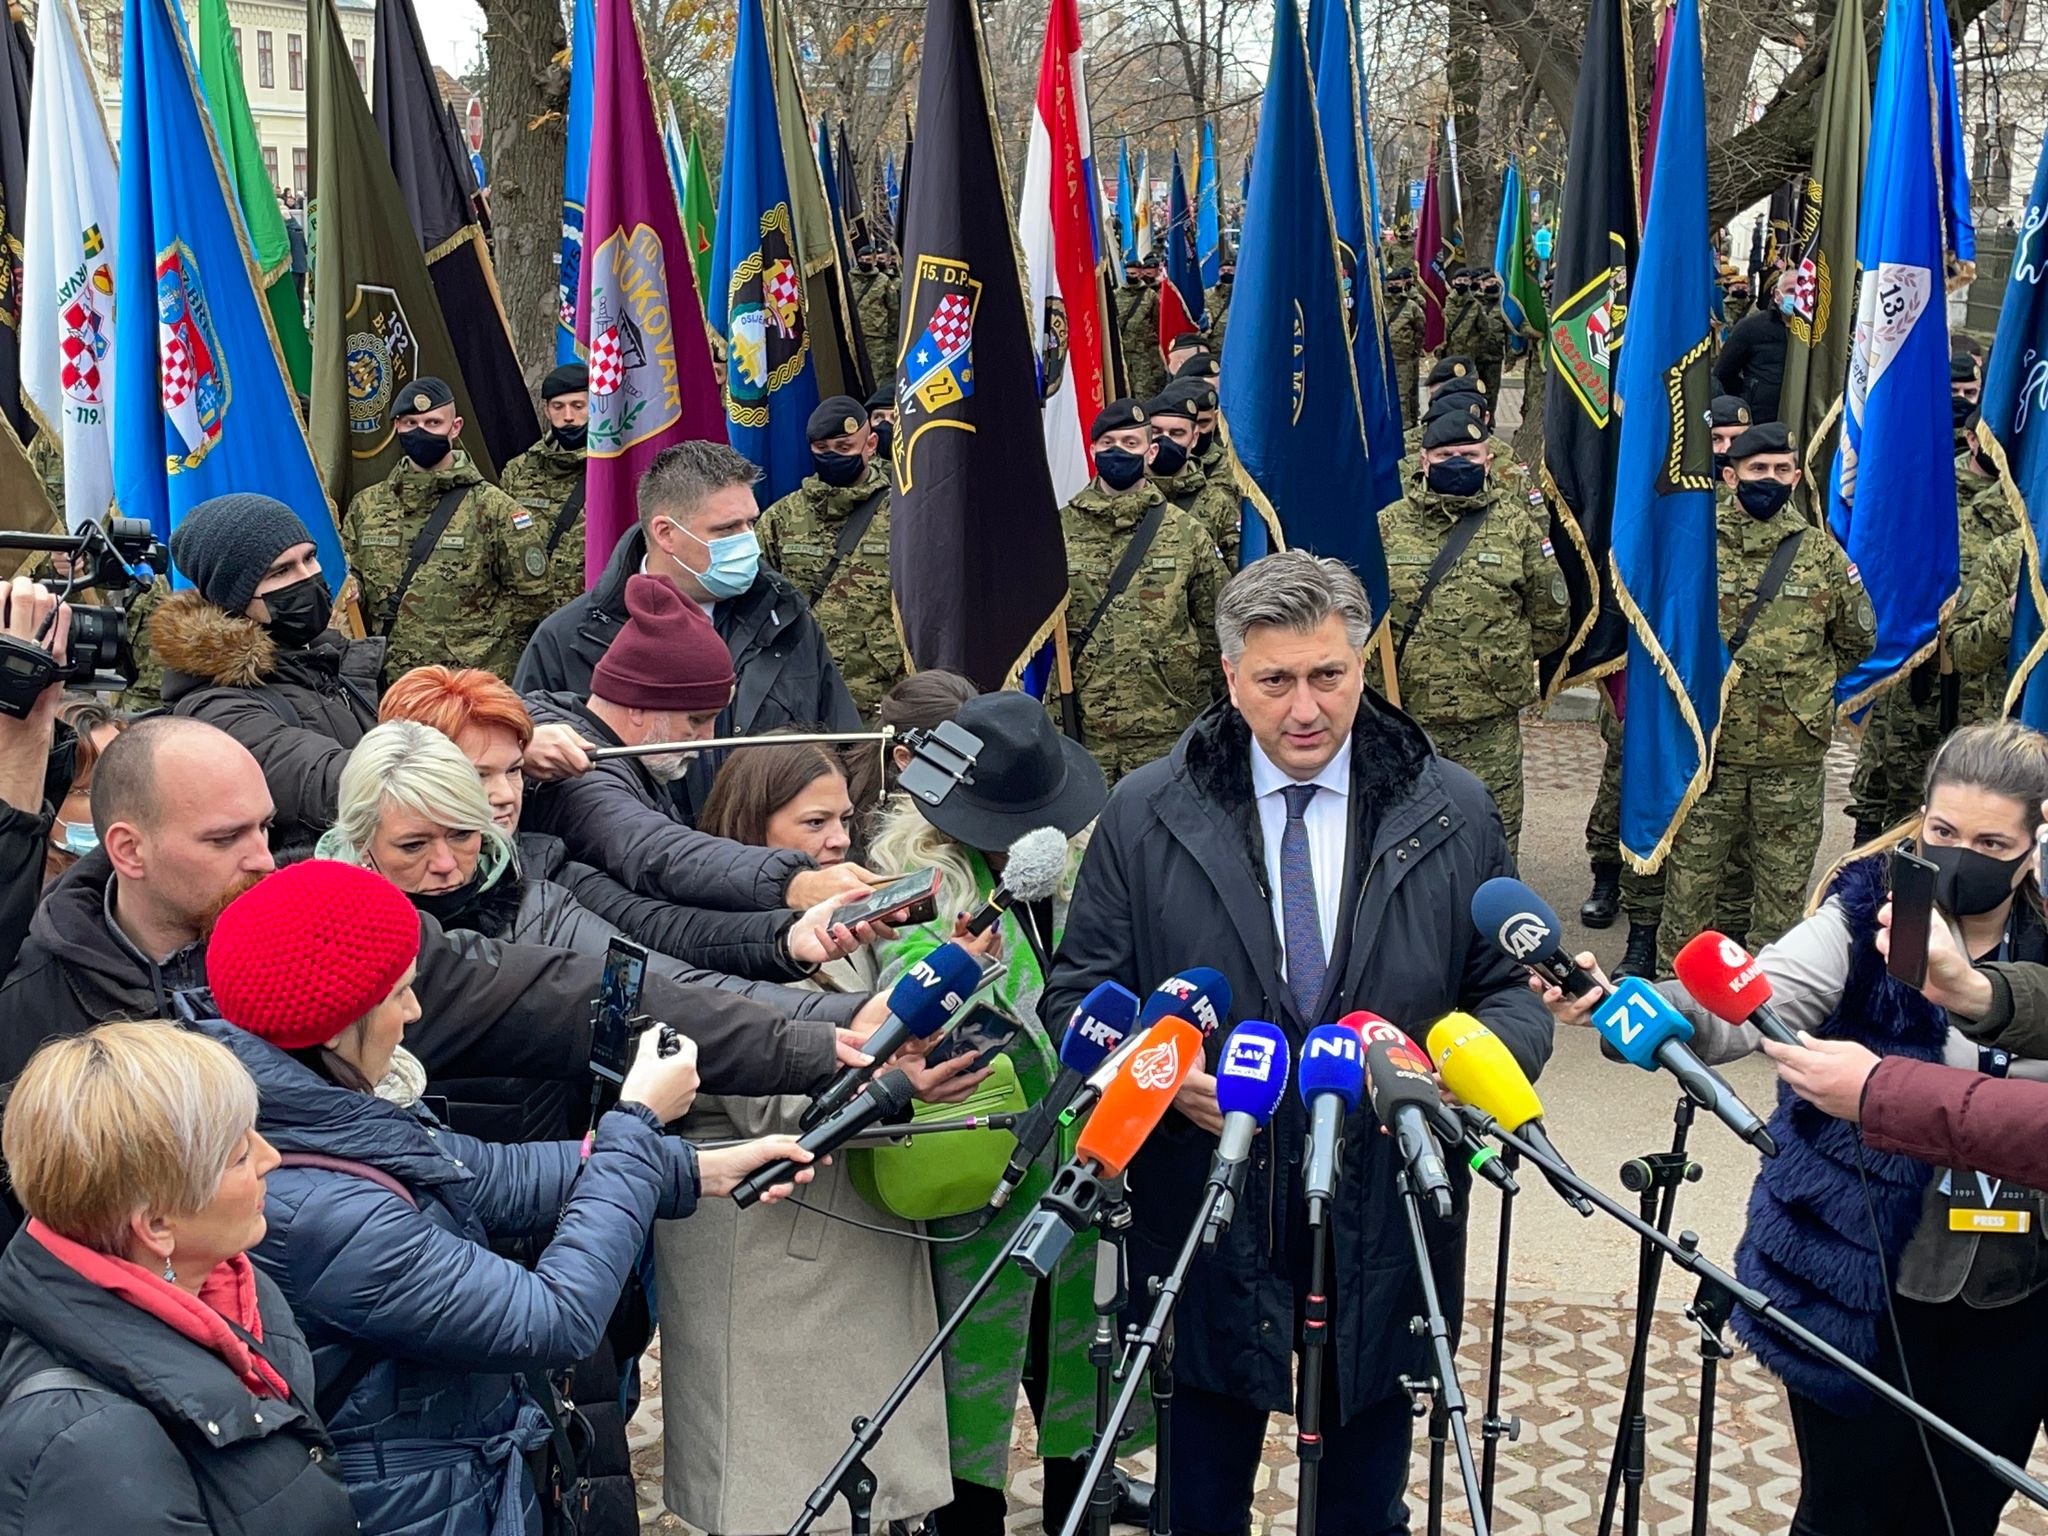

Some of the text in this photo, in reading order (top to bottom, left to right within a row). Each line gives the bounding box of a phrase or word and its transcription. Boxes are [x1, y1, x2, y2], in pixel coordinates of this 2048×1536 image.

[922, 263, 940, 281] 15.
[1880, 284, 1905, 325] 13.
[612, 241, 682, 411] VUKOVAR
[76, 406, 102, 425] 119.
[1079, 1015, 1124, 1052] HRT
[1605, 992, 1659, 1045] Z1
[1310, 1036, 1357, 1060] N1
[1954, 1189, 2025, 1199] 1991 2021
